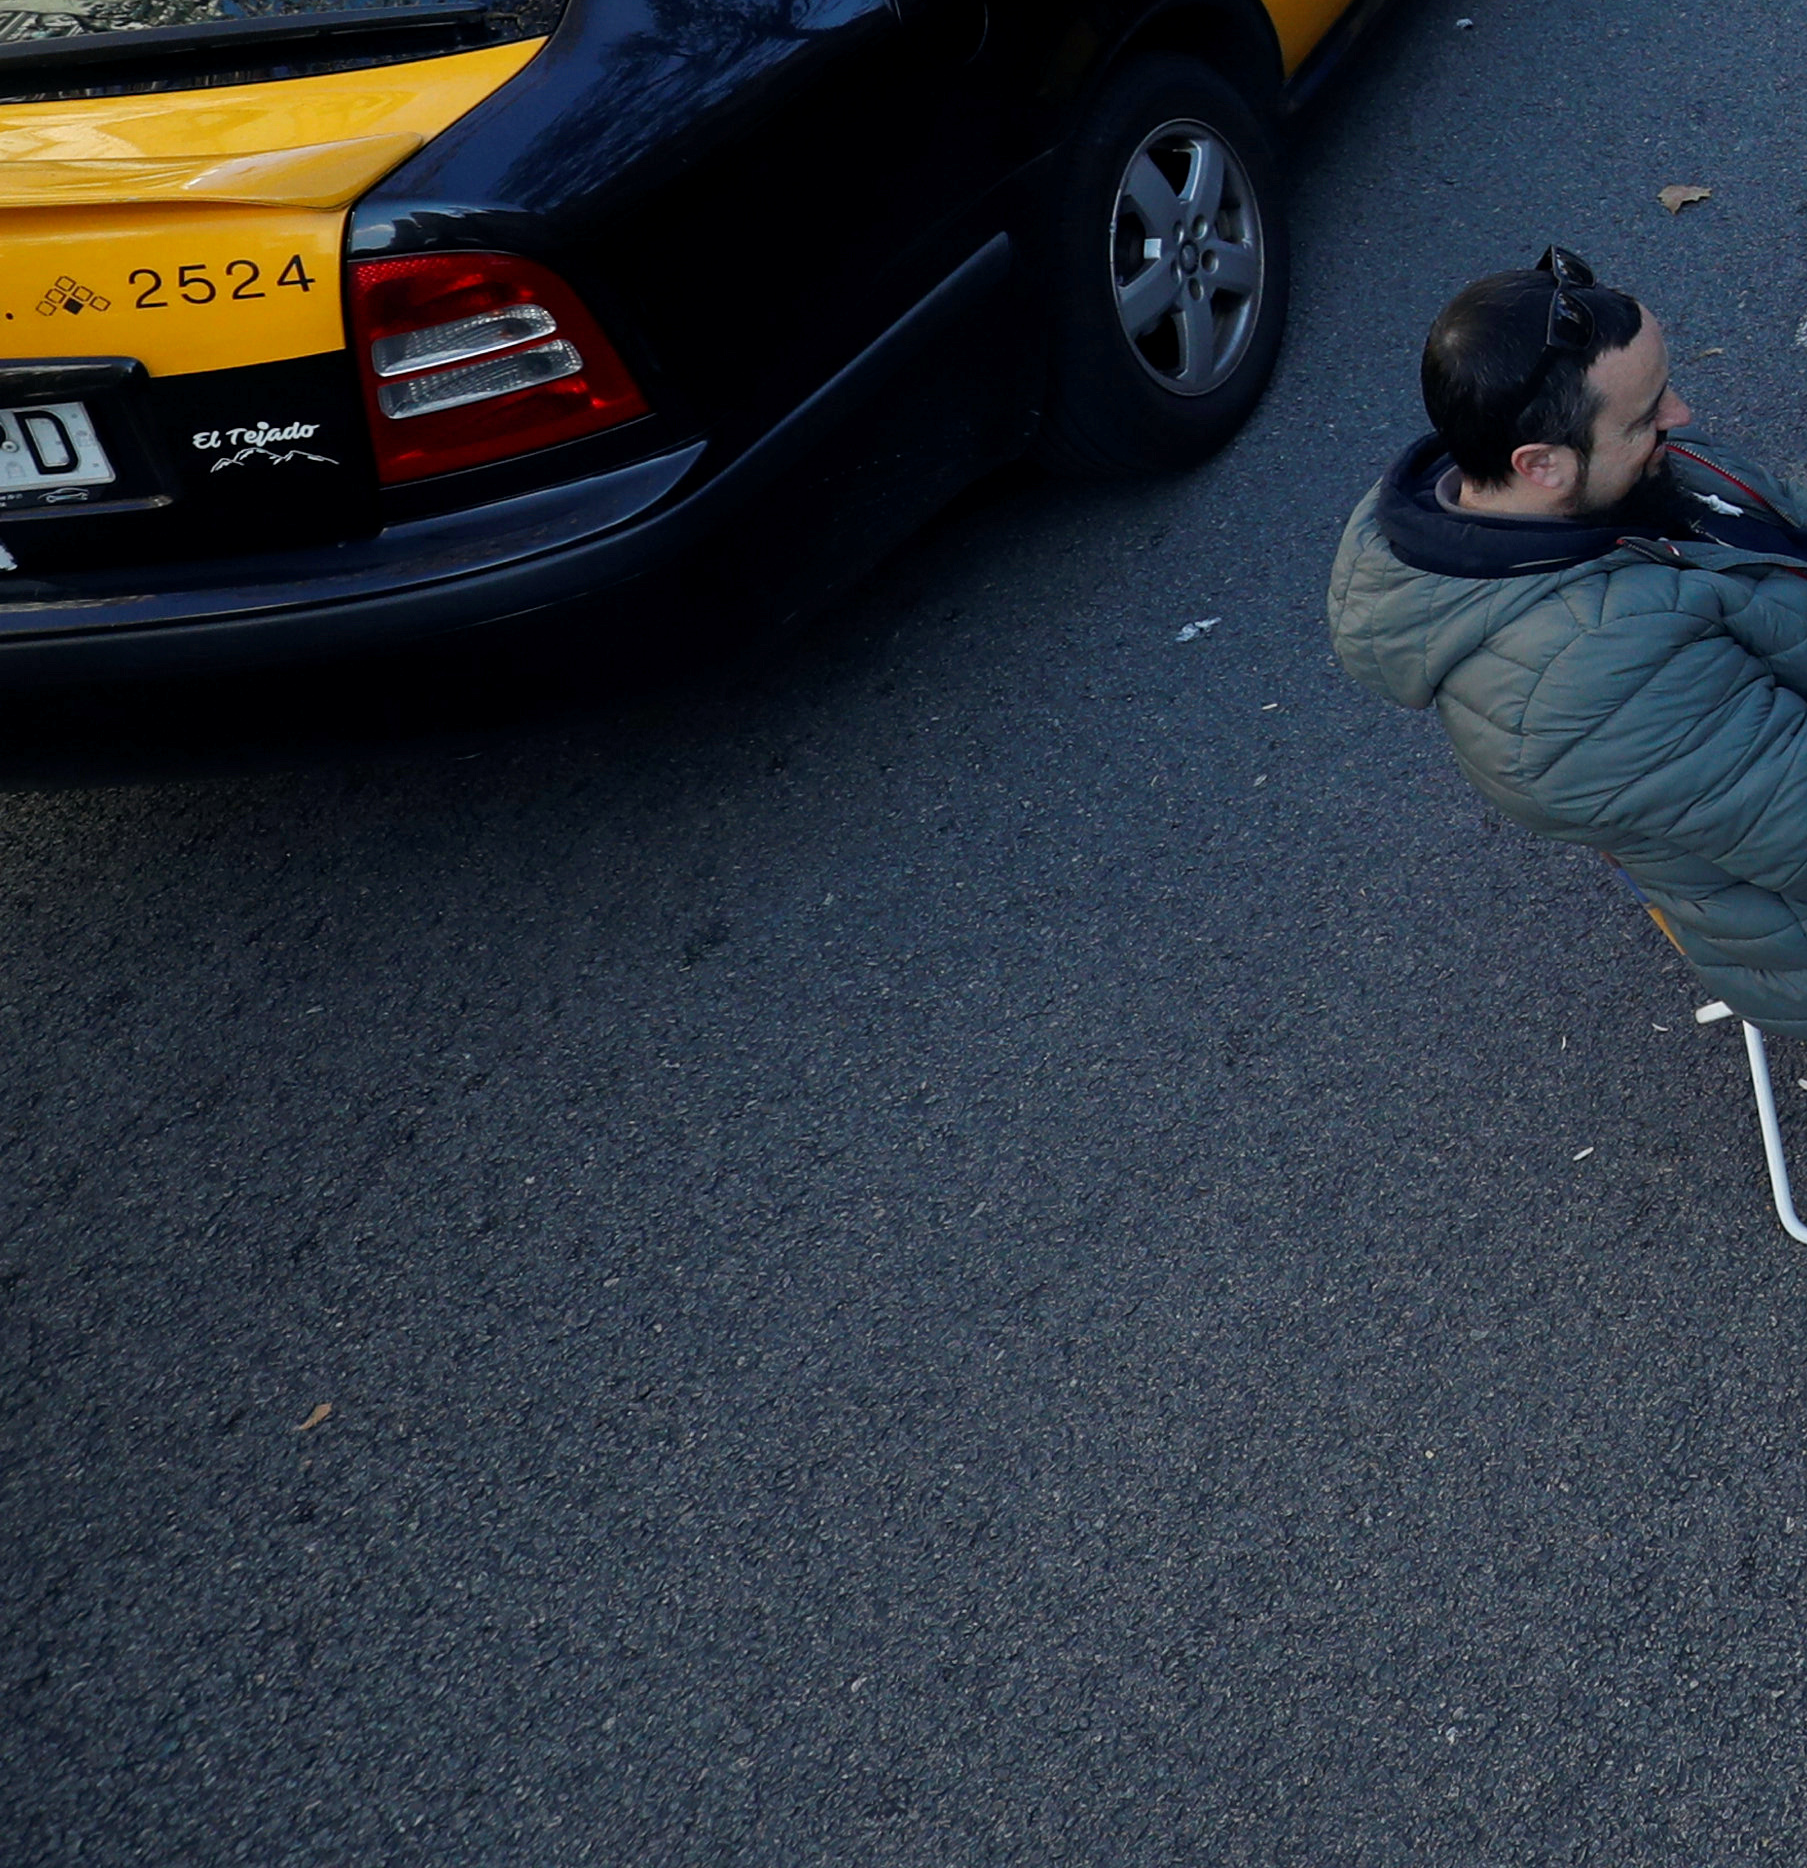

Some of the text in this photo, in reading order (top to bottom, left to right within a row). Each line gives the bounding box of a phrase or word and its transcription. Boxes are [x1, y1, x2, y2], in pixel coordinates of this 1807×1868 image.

[128, 254, 316, 309] 2524
[192, 421, 320, 450] El Tejado
